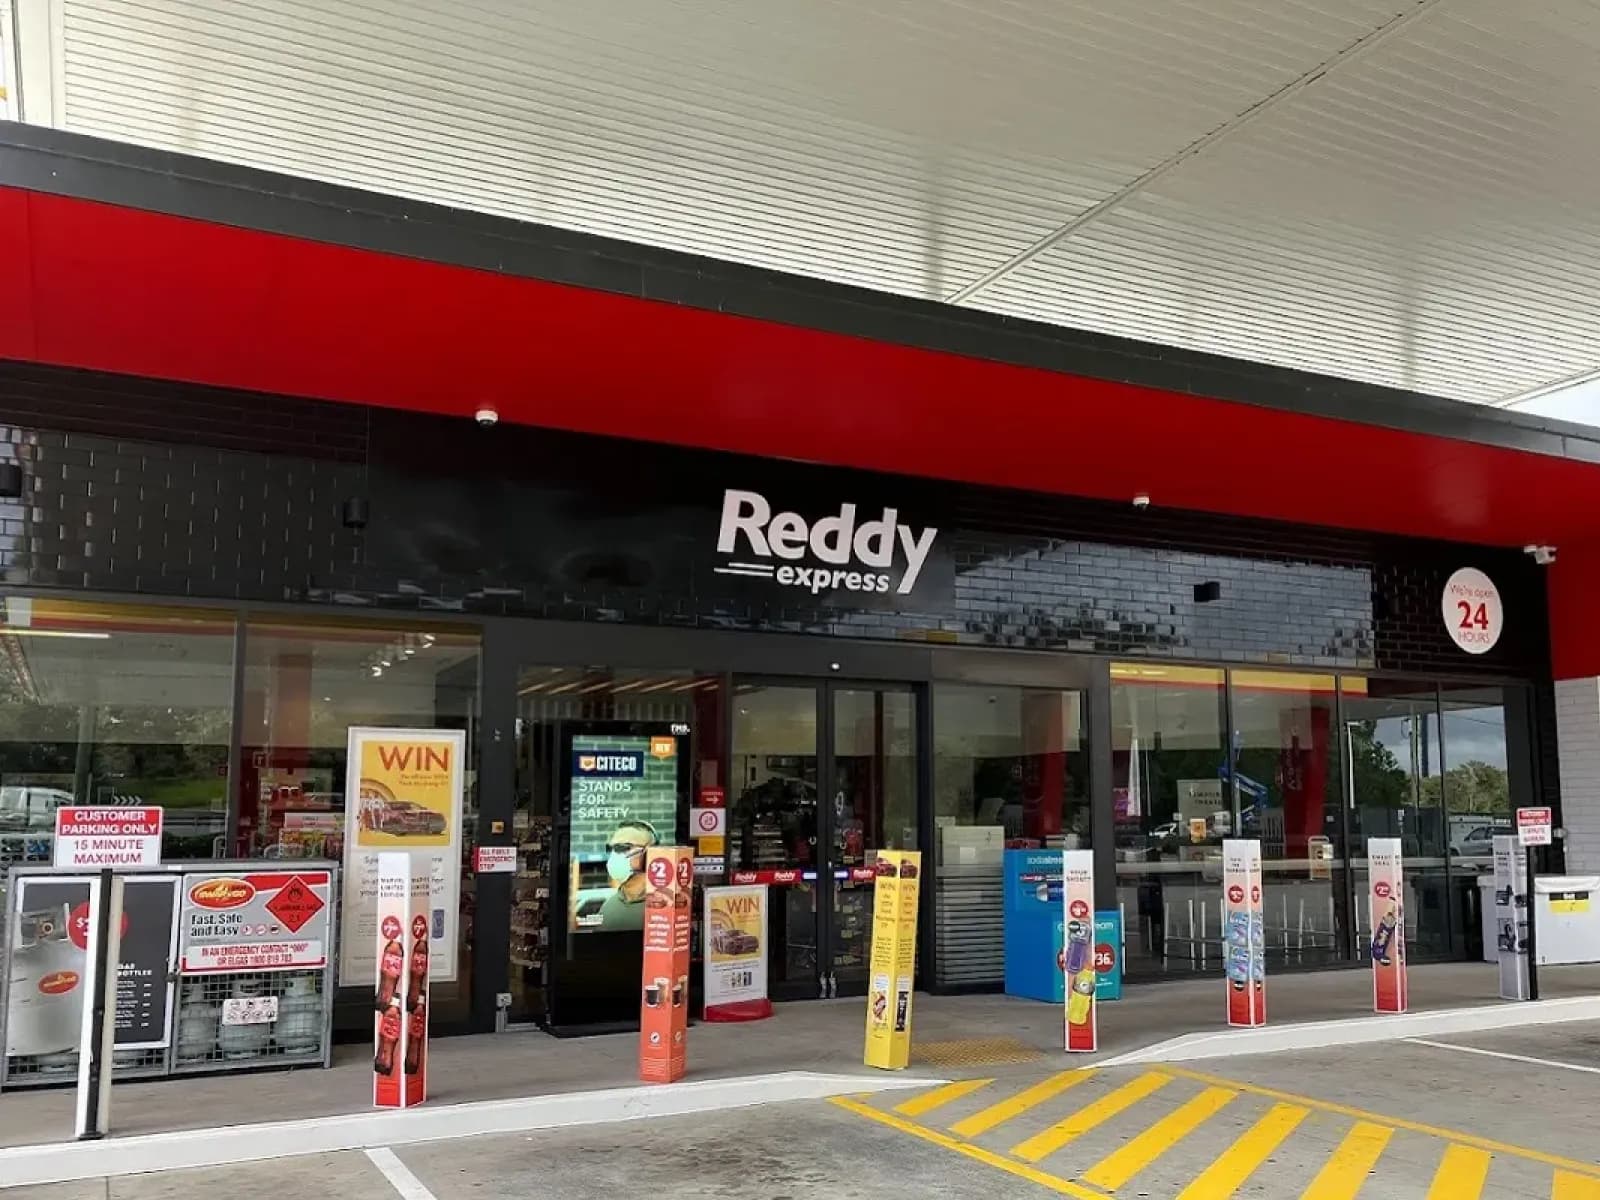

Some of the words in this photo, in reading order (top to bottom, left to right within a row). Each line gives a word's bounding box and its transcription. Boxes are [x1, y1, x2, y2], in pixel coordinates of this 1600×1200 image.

[717, 488, 938, 594] Reddy
[776, 566, 890, 594] express
[1457, 601, 1489, 630] 24
[378, 745, 449, 771] WIN
[596, 755, 637, 771] CITECO
[578, 781, 631, 792] STANDS
[578, 794, 606, 805] FOR
[74, 810, 146, 822] CUSTOMER
[578, 807, 630, 818] SAFETY
[62, 824, 120, 835] PARKING
[122, 823, 157, 834] ONLY
[74, 839, 88, 850] 15
[92, 839, 145, 850] MINUTE
[73, 854, 142, 865] MAXIMUM
[726, 896, 760, 914] WIN
[218, 912, 243, 924] Safe
[191, 926, 212, 937] and
[213, 925, 240, 937] Easy
[220, 945, 260, 956] EMERGENCY
